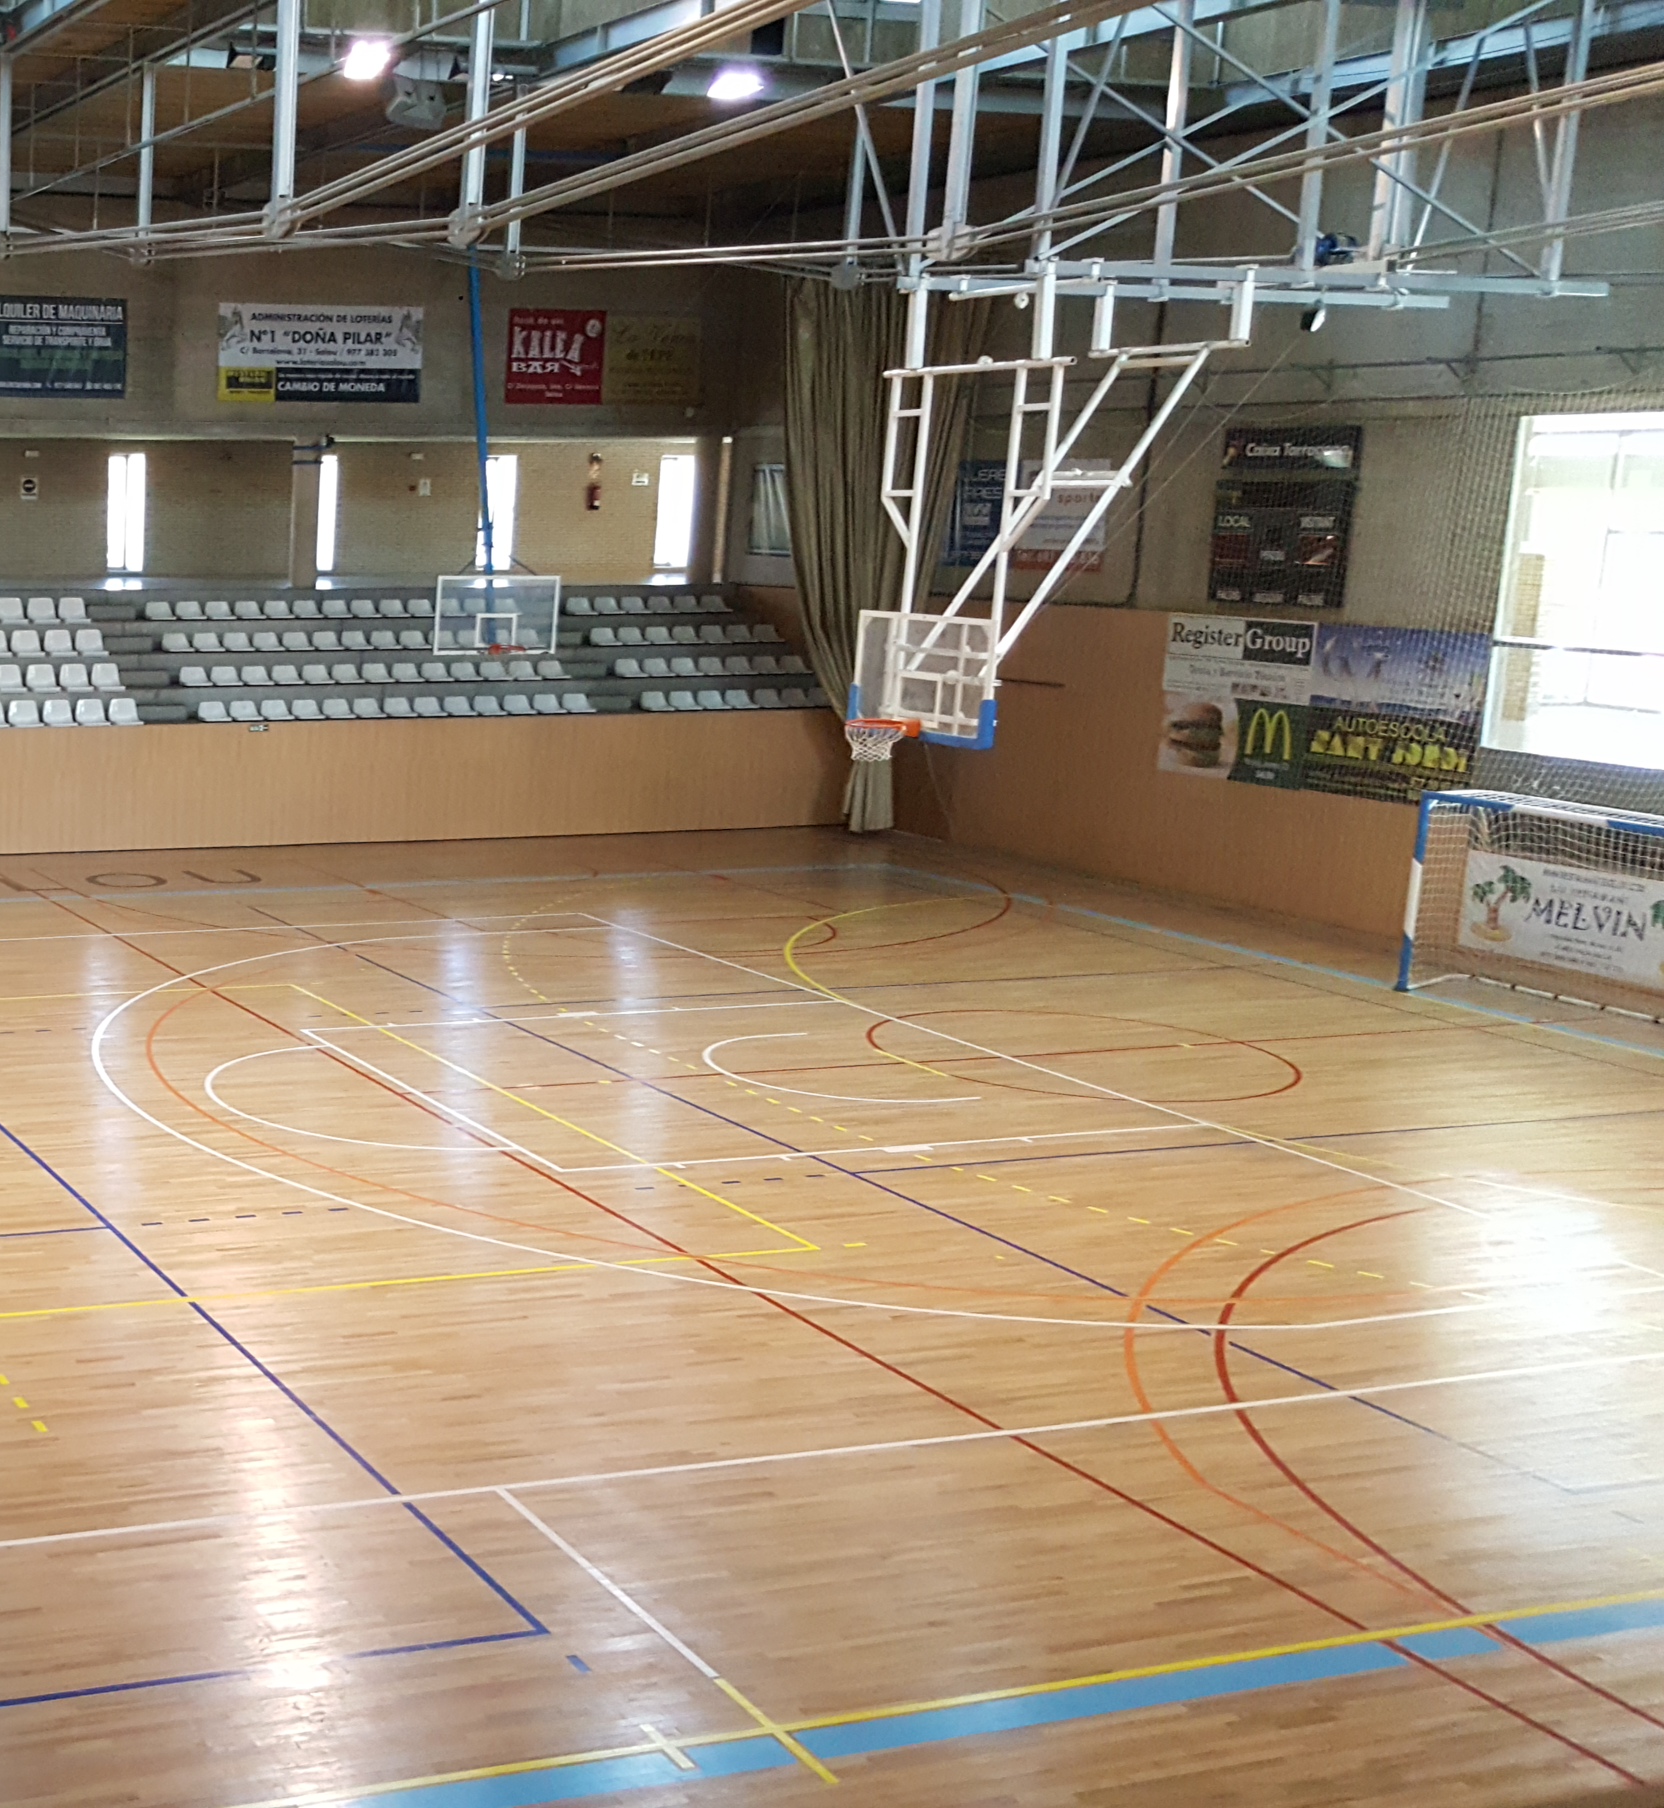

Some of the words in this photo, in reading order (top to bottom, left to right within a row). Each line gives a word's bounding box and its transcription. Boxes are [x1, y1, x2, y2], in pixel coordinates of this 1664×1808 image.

[42, 303, 57, 319] DE
[58, 304, 123, 320] MAQUINARIA
[250, 311, 334, 324] ADMINISTRACIÓN
[336, 314, 348, 323] DE
[350, 313, 393, 324] LOTERÍAS
[511, 326, 585, 362] KALEA
[277, 380, 320, 392] CAMBIO
[322, 382, 336, 392] DE
[338, 382, 385, 393] MONEDA
[1245, 443, 1281, 457] Caixa
[1218, 515, 1251, 528] LOCAL
[1171, 622, 1242, 649] Register
[1245, 628, 1311, 658] Group
[1335, 715, 1447, 743] AUTOESCOLA
[1525, 896, 1648, 942] MELVIN
